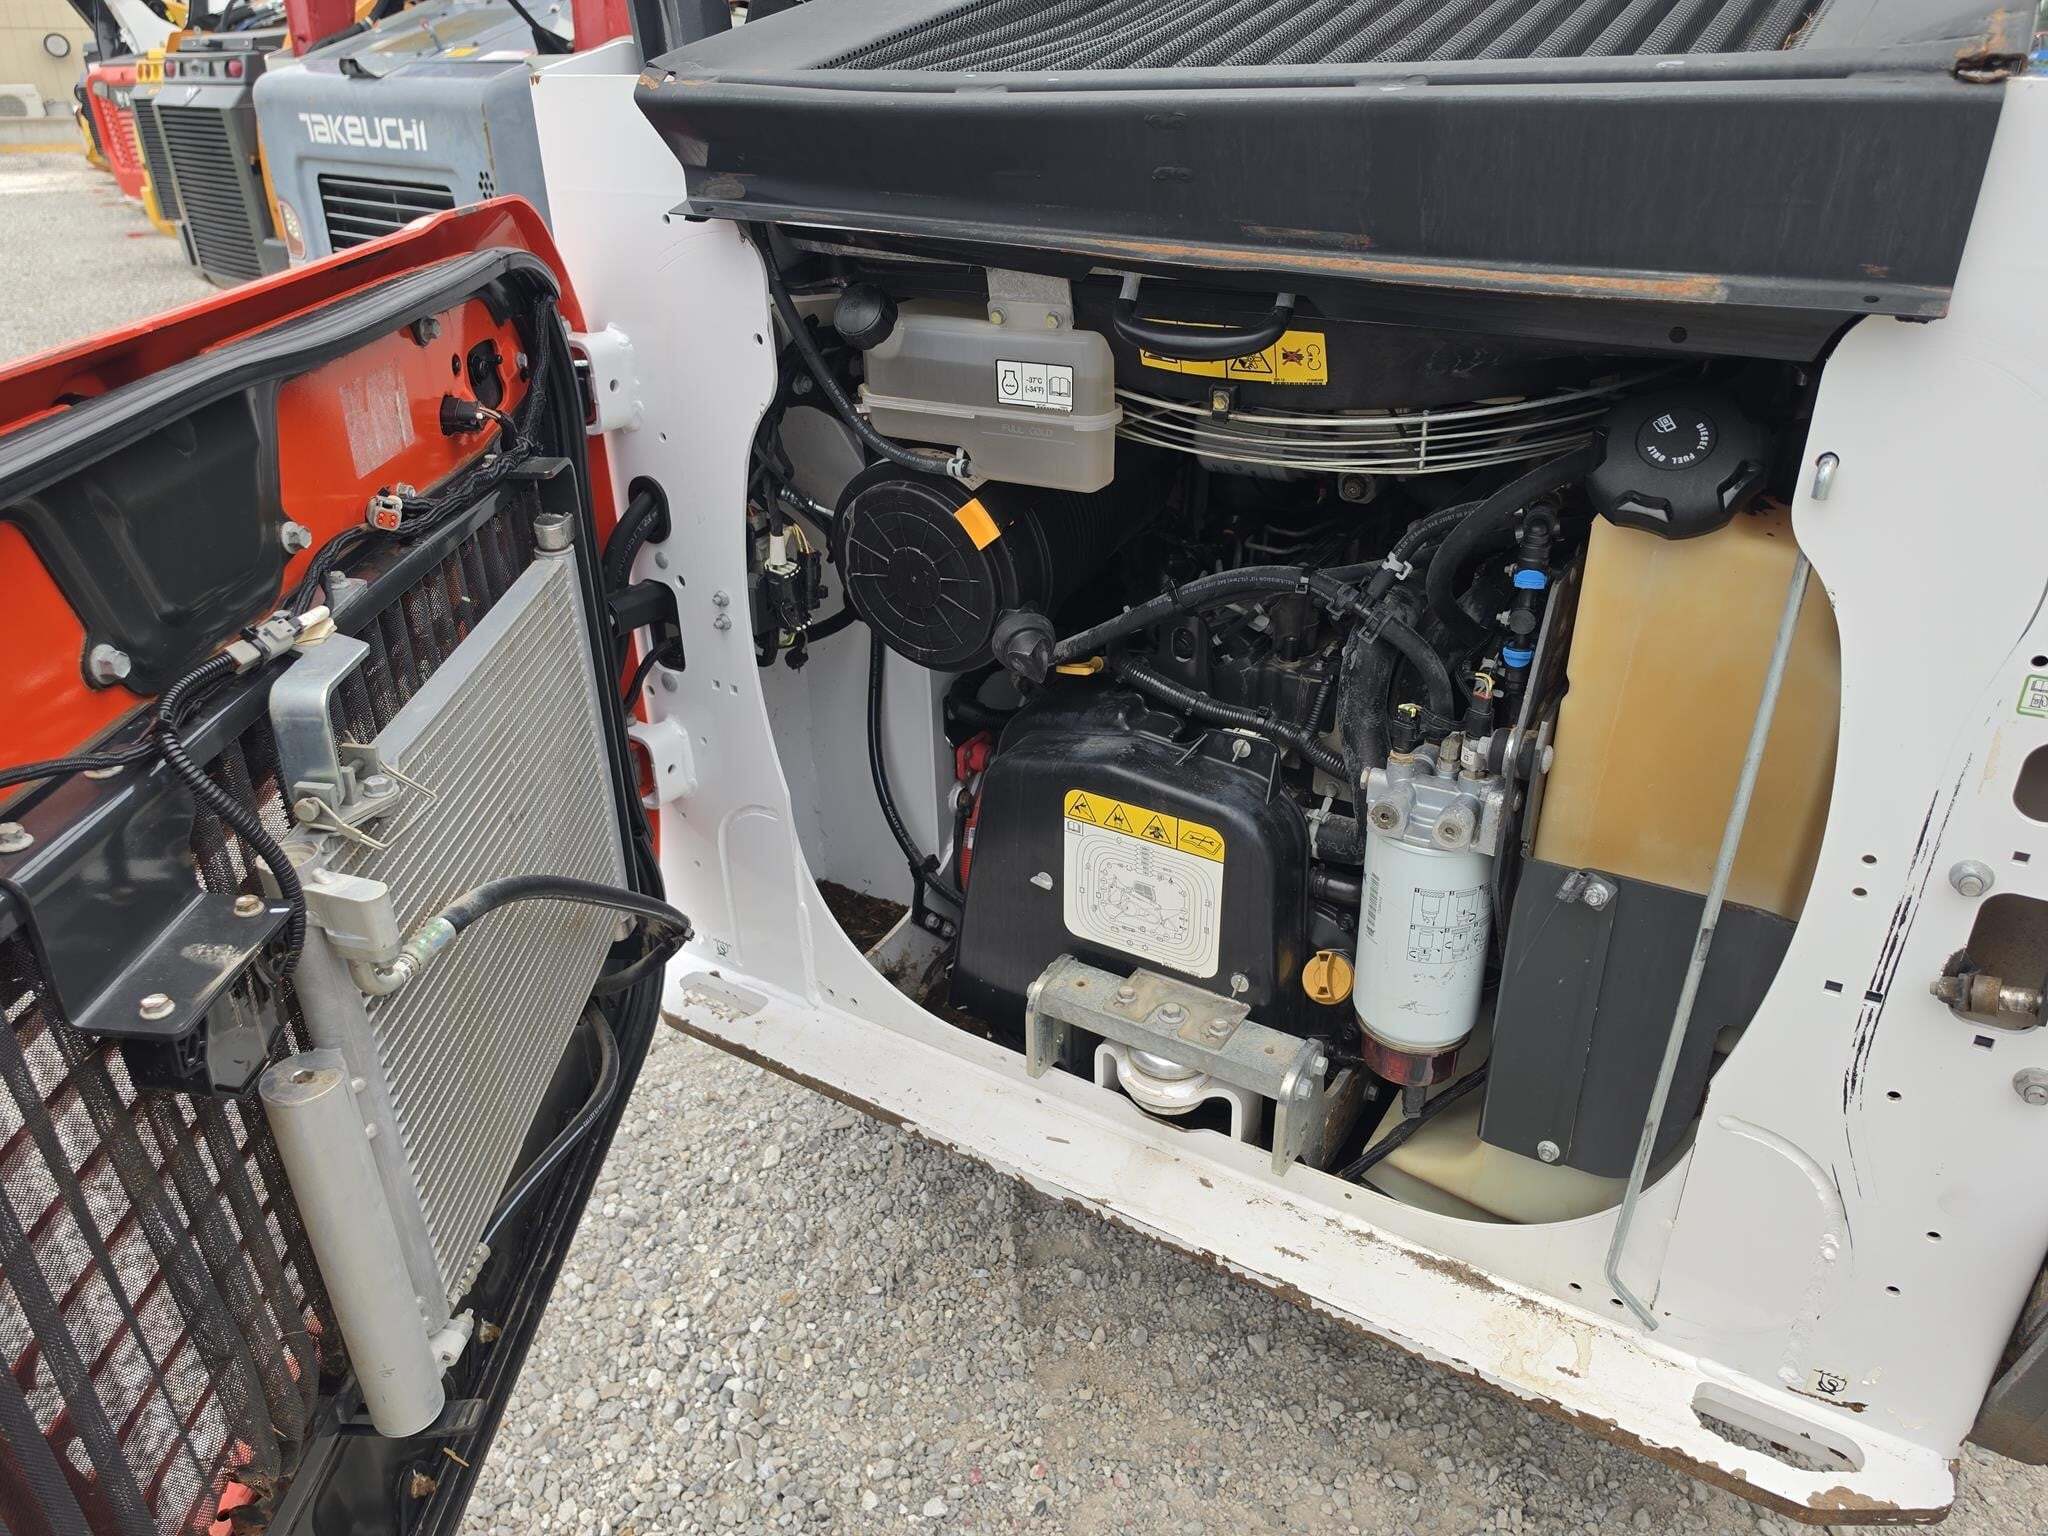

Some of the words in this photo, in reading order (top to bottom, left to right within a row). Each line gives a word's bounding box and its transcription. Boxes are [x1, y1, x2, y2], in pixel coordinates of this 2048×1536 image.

[298, 112, 427, 151] TAKEUCHI
[1696, 422, 1709, 450] DIESEL
[1646, 445, 1666, 462] ONLY
[1672, 452, 1695, 464] FUEL
